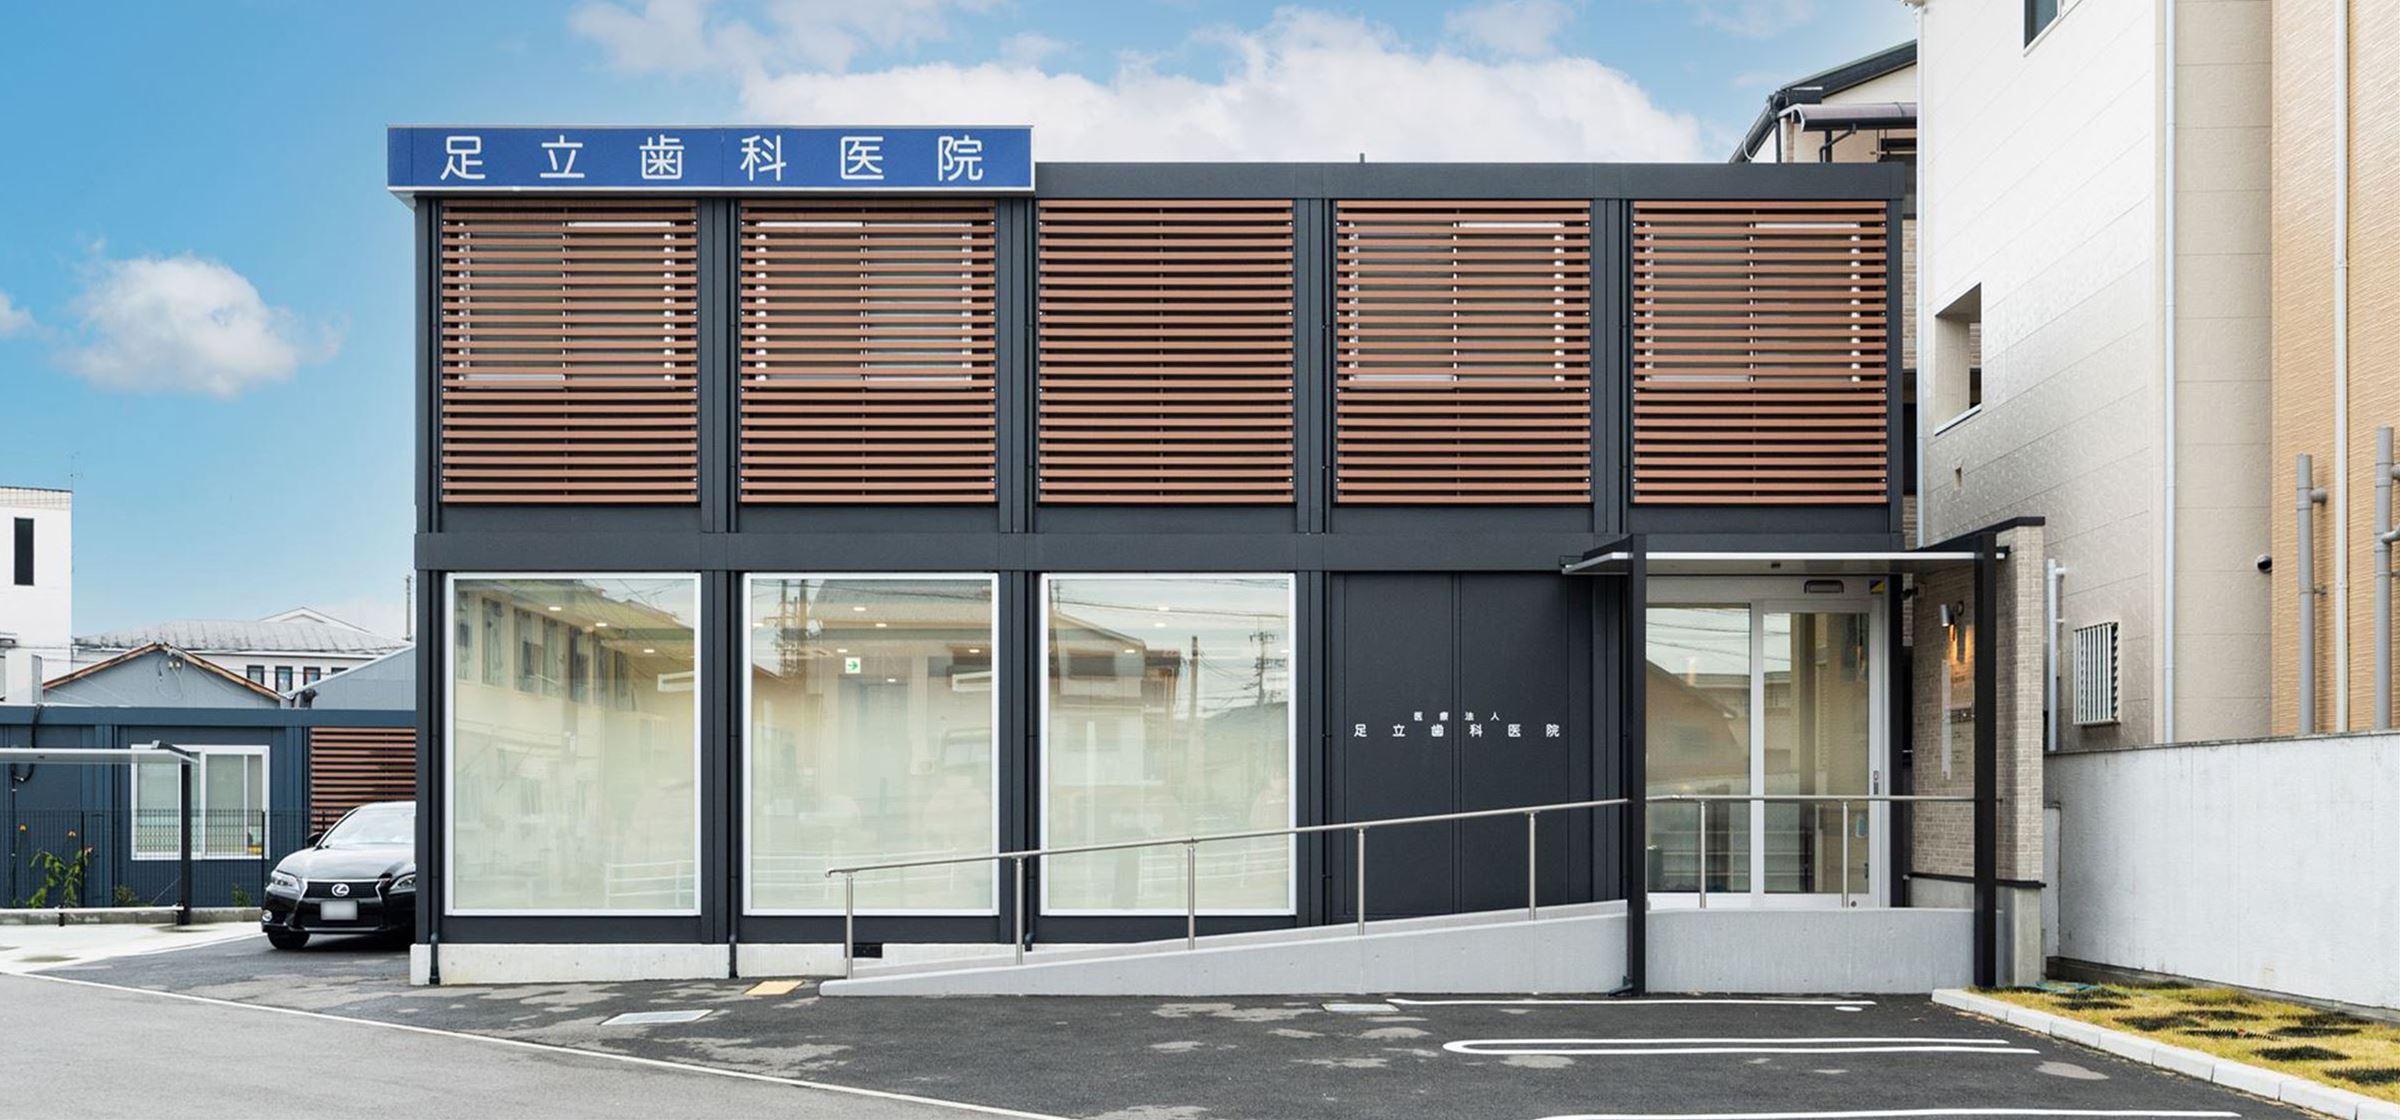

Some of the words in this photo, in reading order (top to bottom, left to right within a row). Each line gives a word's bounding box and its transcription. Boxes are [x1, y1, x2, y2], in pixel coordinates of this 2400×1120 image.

[440, 134, 983, 181] 足立歯科医院
[1353, 723, 1560, 738] 足立歯科医院
